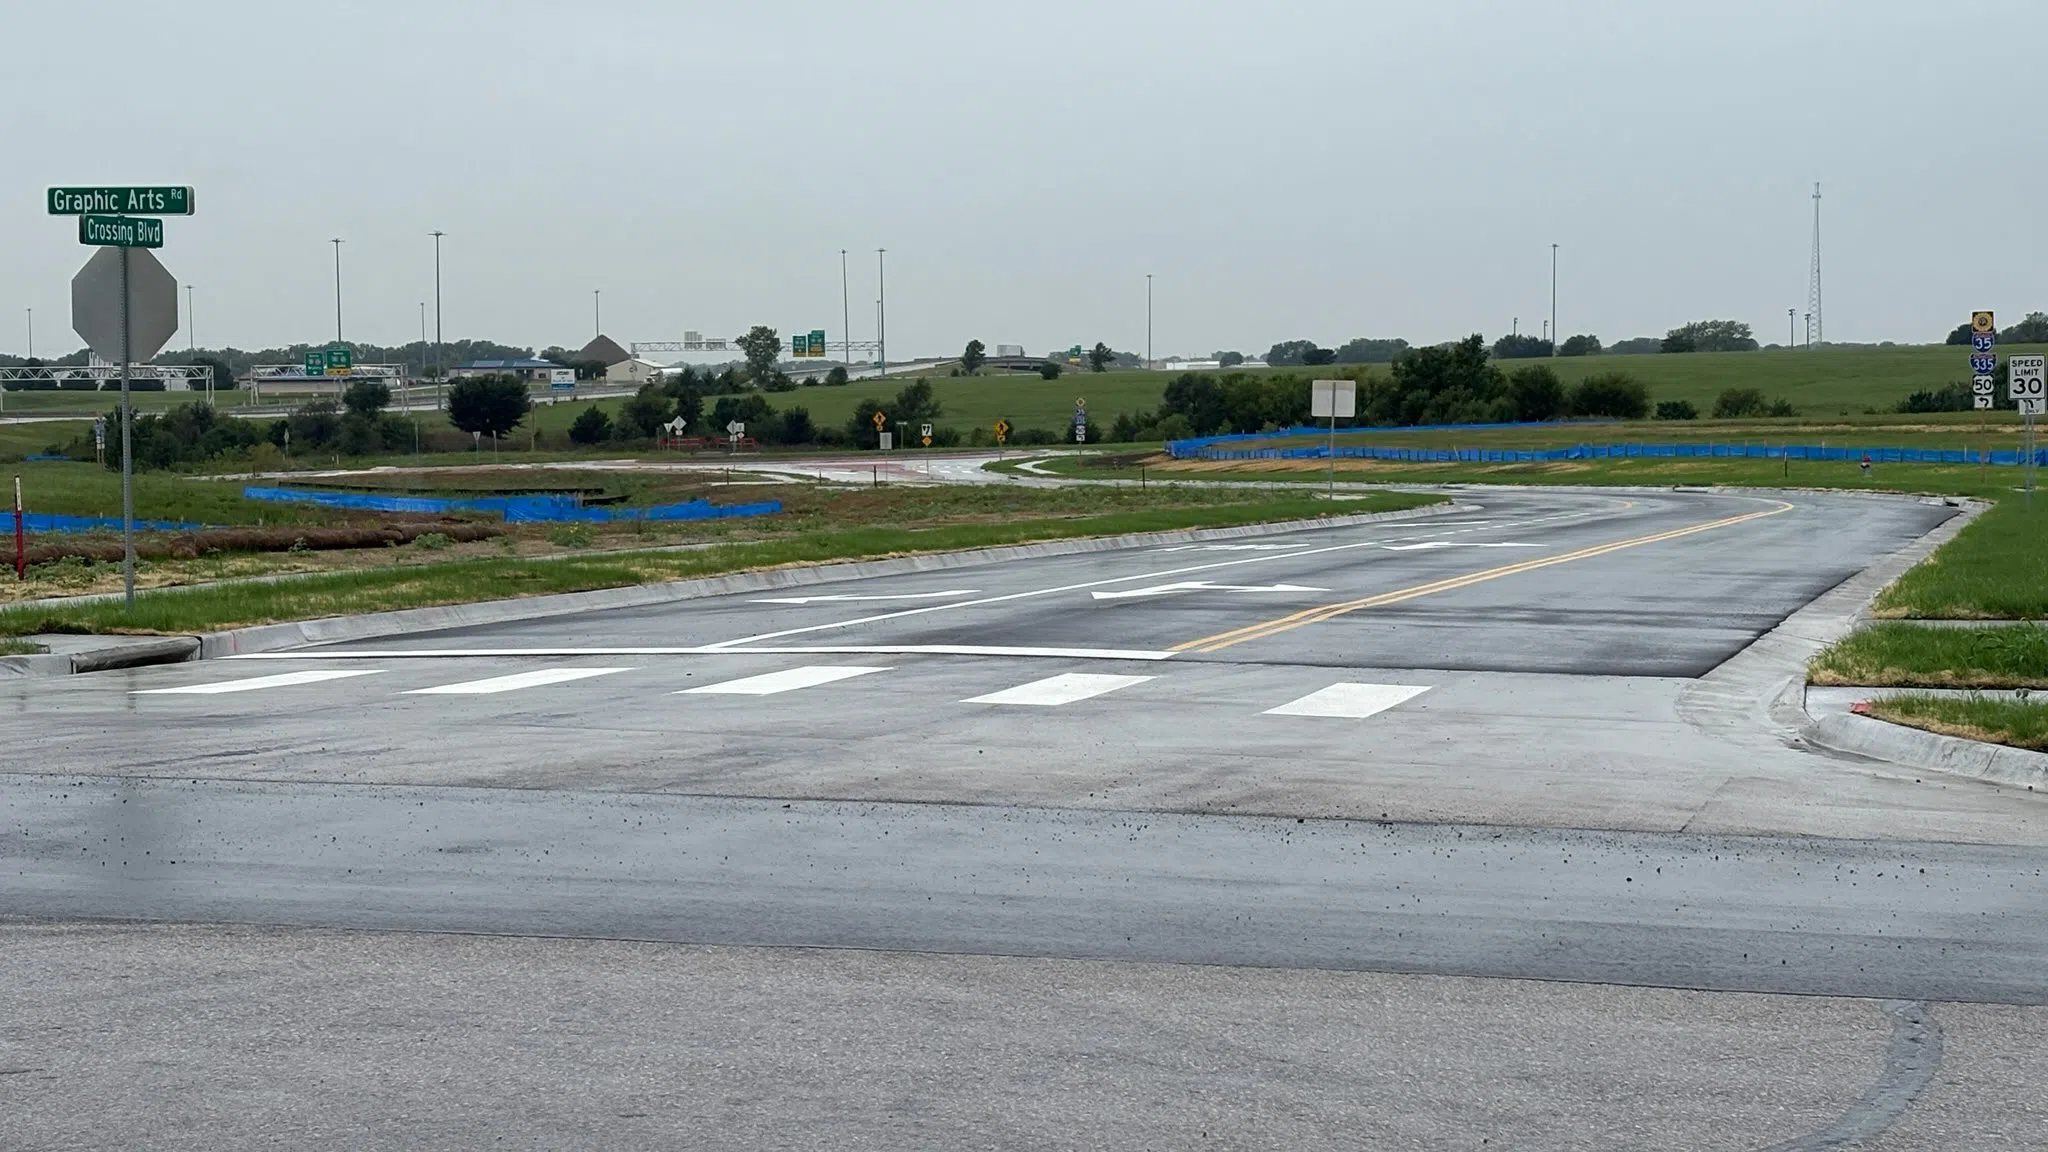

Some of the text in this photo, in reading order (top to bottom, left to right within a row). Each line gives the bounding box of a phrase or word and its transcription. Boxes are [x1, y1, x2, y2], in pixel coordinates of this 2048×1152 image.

[54, 189, 182, 213] Graphic Arts Rd
[88, 219, 161, 244] Crossing Blvd
[1975, 338, 1992, 349] 35
[1973, 359, 1994, 370] 335
[1975, 379, 1992, 391] 50
[2012, 378, 2042, 394] 30
